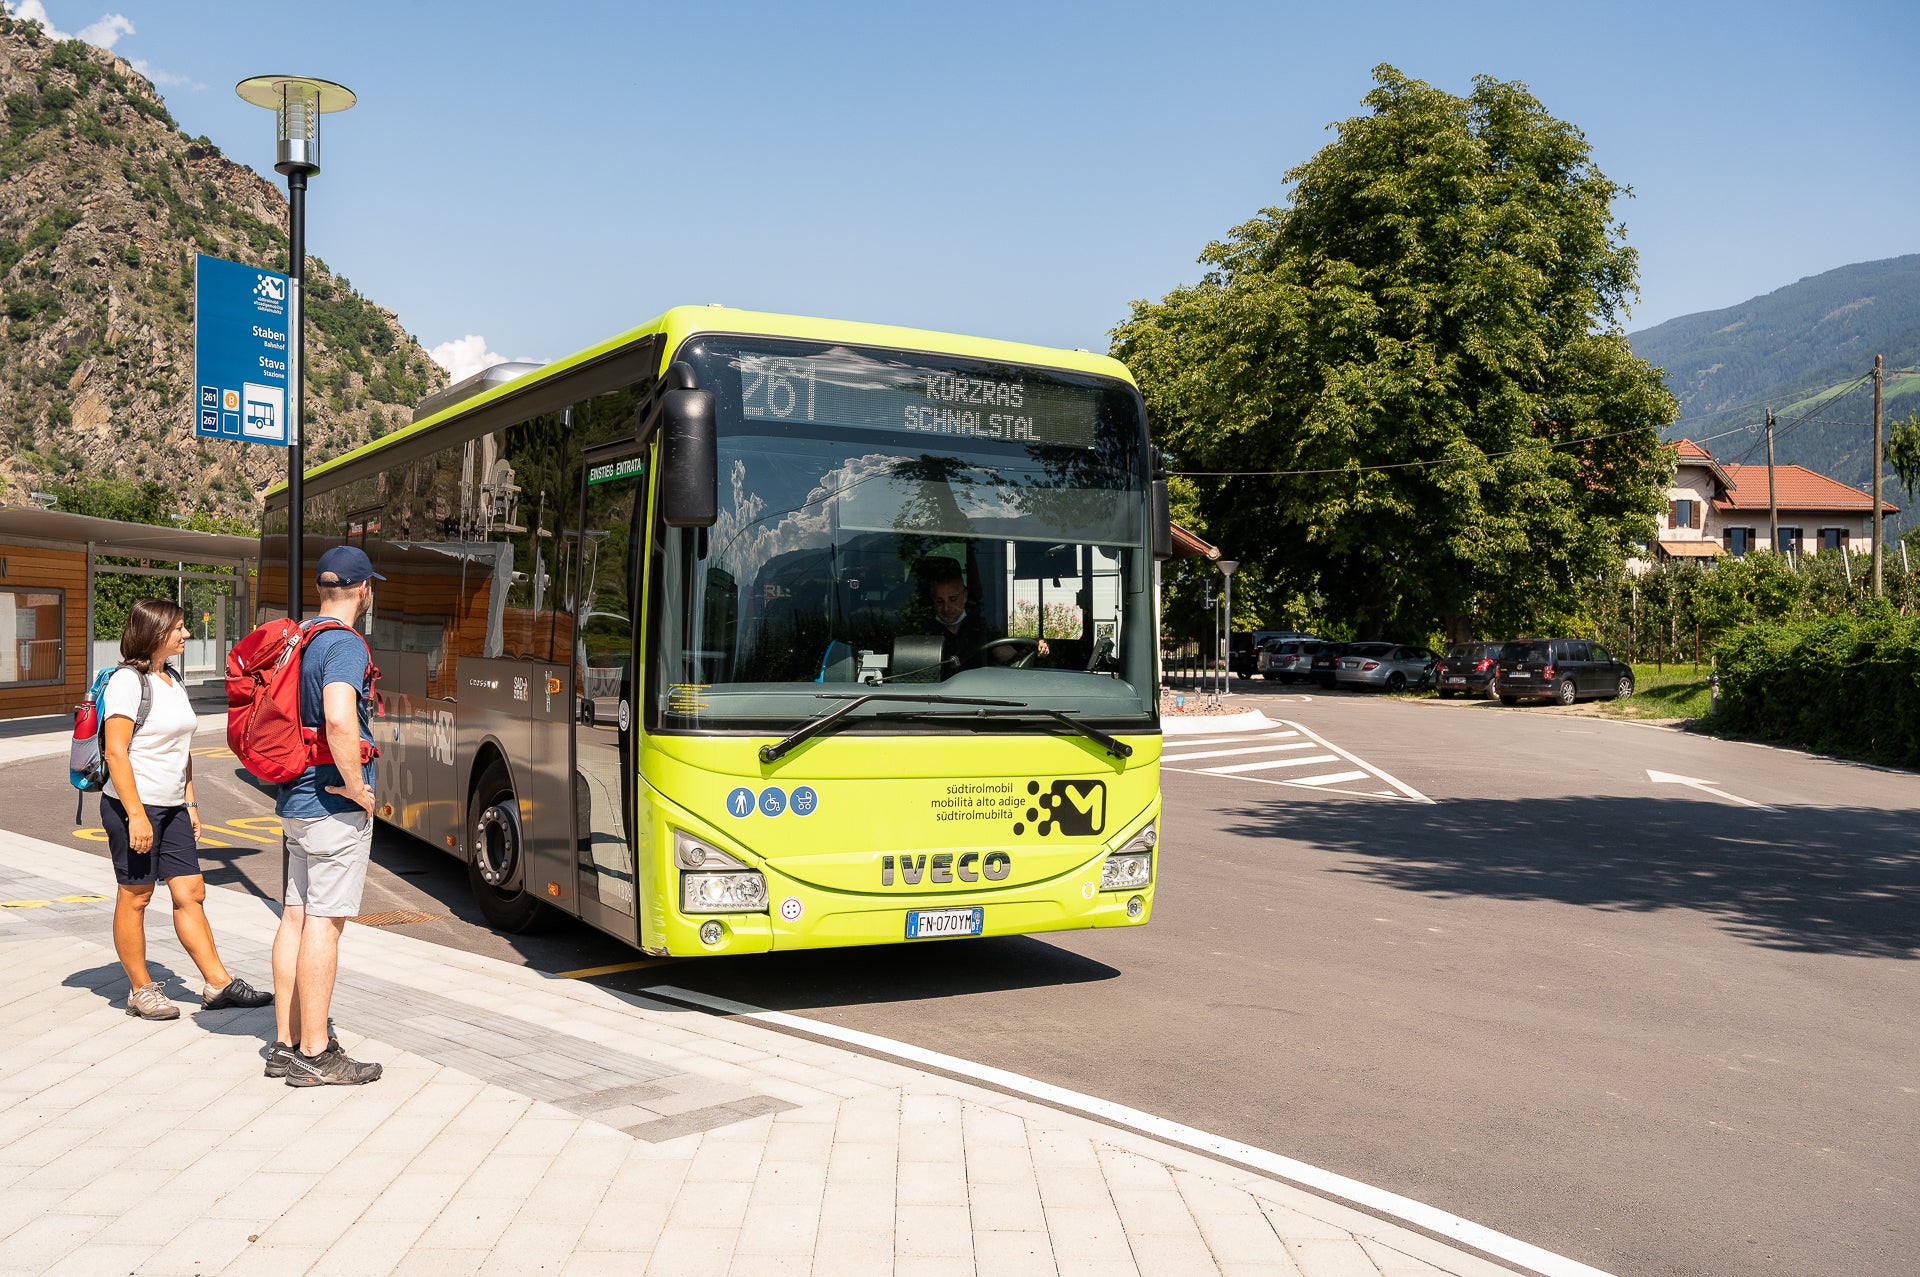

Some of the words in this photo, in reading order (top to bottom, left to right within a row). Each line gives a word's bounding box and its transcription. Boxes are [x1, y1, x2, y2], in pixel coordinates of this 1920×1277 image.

[252, 325, 285, 341] Staben
[264, 341, 285, 350] Bahnhof
[259, 356, 285, 371] Stava
[263, 370, 285, 379] Stazione
[741, 355, 816, 421] 261
[926, 374, 1024, 408] KURZRAS
[203, 392, 216, 402] 261
[228, 395, 235, 406] B
[203, 416, 216, 426] 267
[904, 404, 1041, 441] SCHNALSTAL
[590, 463, 614, 481] EINSTIEG
[616, 457, 642, 475] ENTRATA
[946, 783, 1013, 794] südtirolmobil
[931, 796, 973, 808] mobilità
[976, 796, 996, 807] alto
[998, 796, 1026, 809] adige
[936, 809, 1013, 821] südtirolmubiltà
[881, 851, 1011, 886] IVECO
